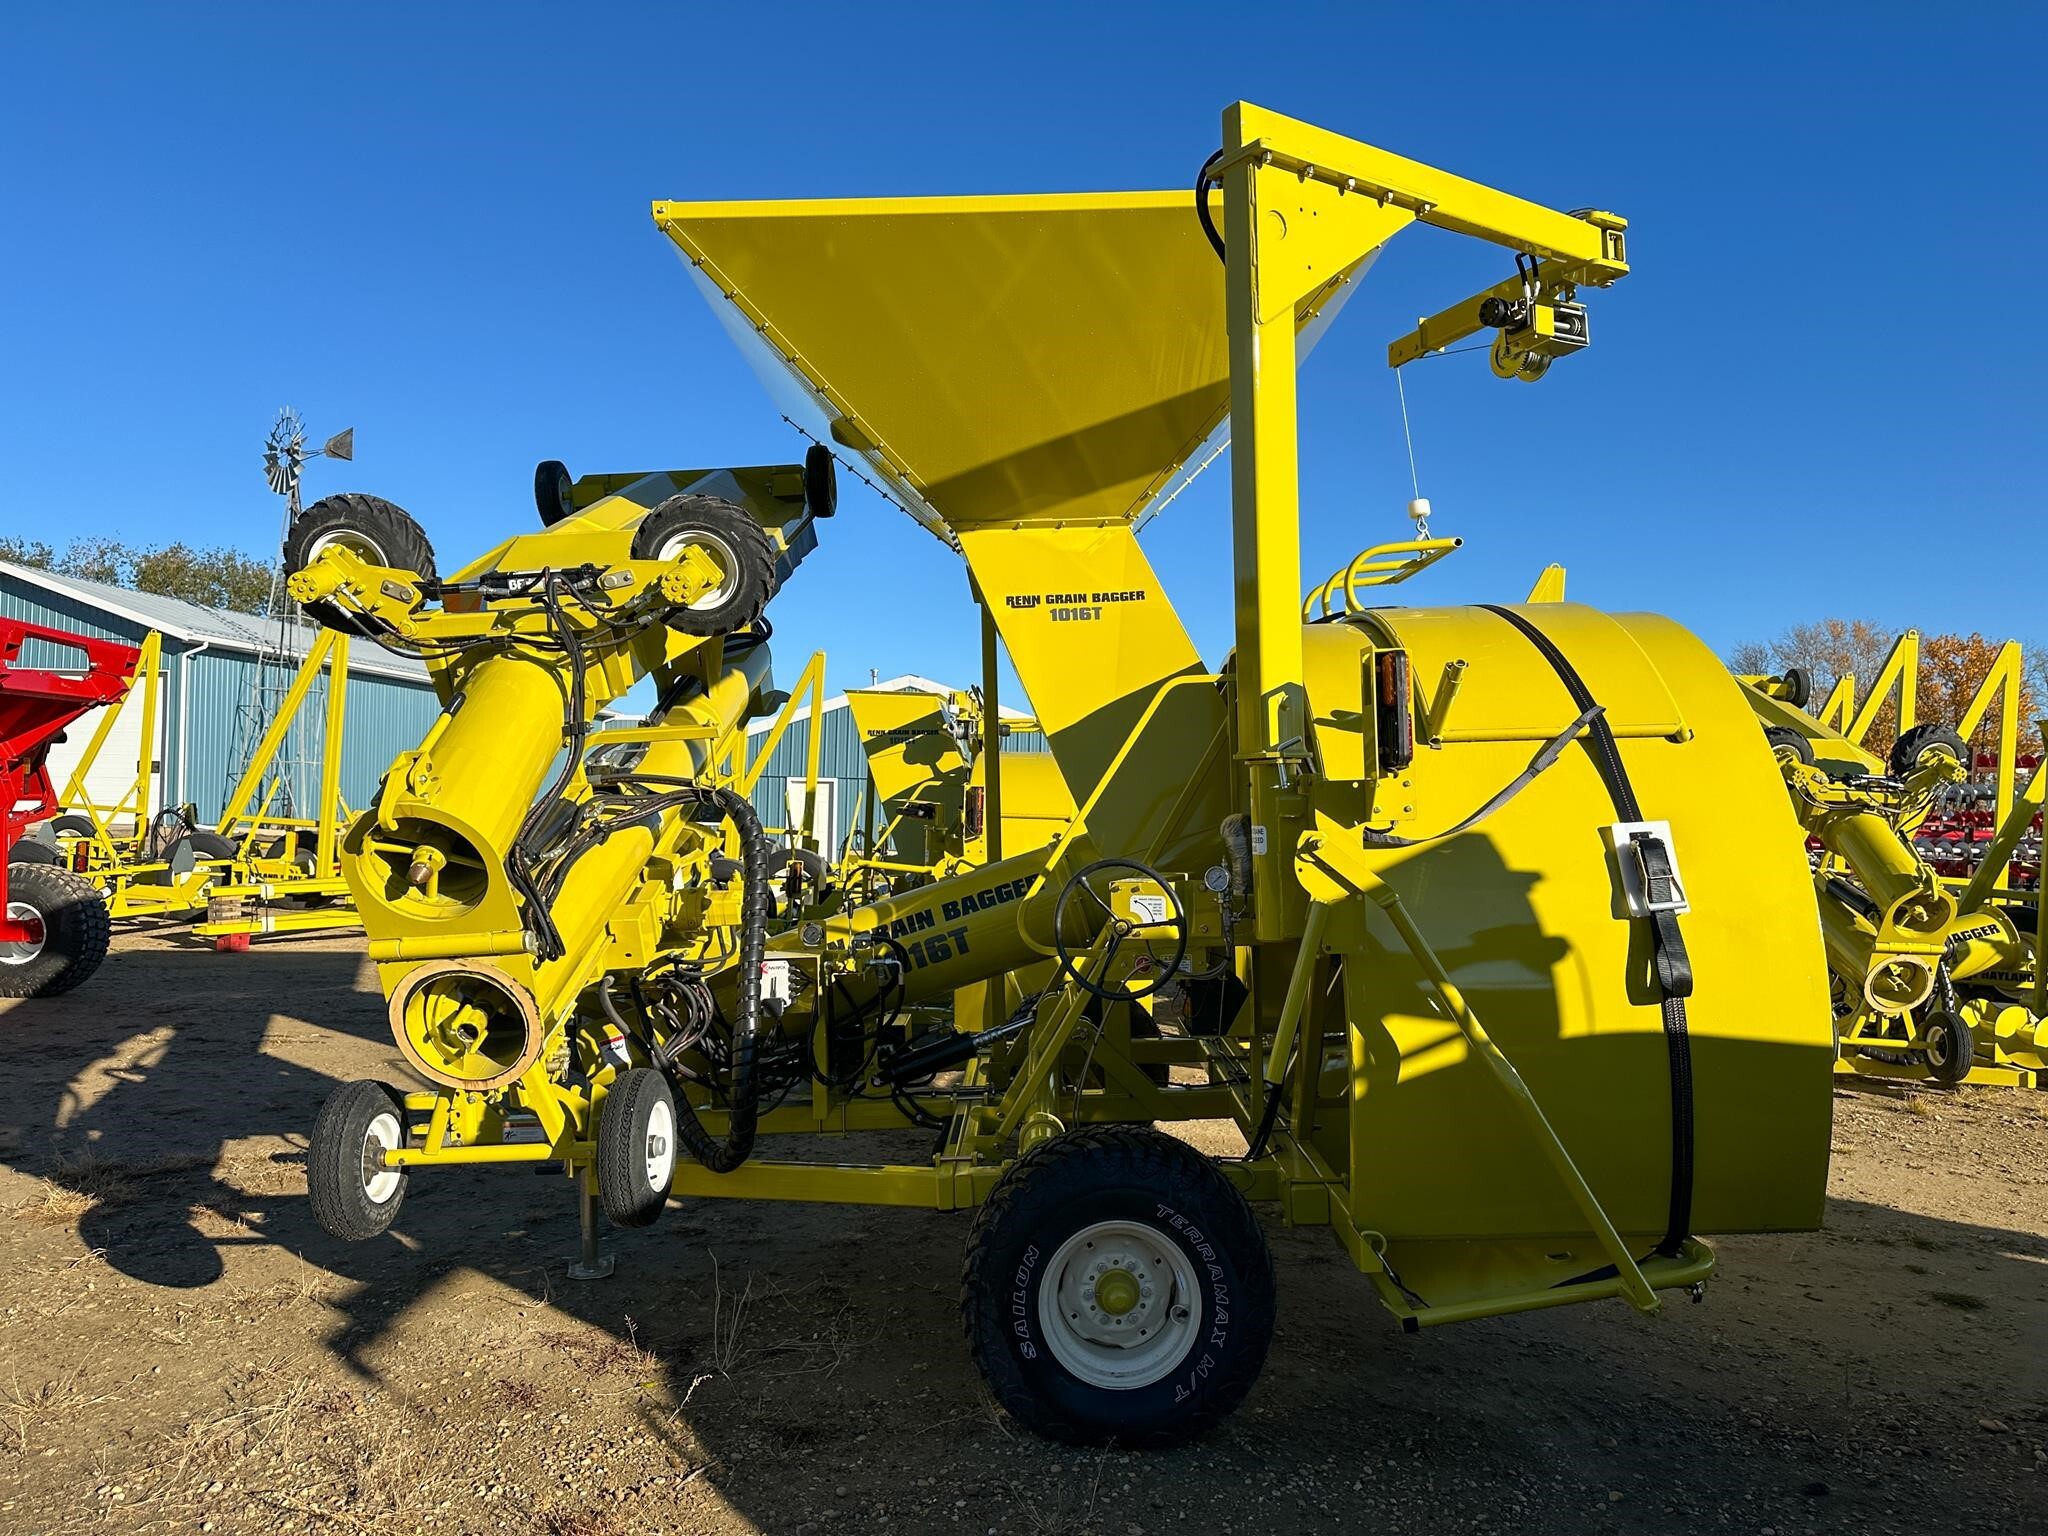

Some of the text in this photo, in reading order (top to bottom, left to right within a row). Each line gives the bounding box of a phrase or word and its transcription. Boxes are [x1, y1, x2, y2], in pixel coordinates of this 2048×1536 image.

[1005, 590, 1146, 609] RENN GRAIN BAGGER
[1050, 606, 1102, 622] 1016T
[857, 908, 936, 944] RAIN
[1948, 923, 2001, 943] AGGER
[890, 926, 971, 973] 16T
[1012, 1245, 1040, 1360] SAILUN
[1157, 1203, 1230, 1403] TERRAMAX M/T
